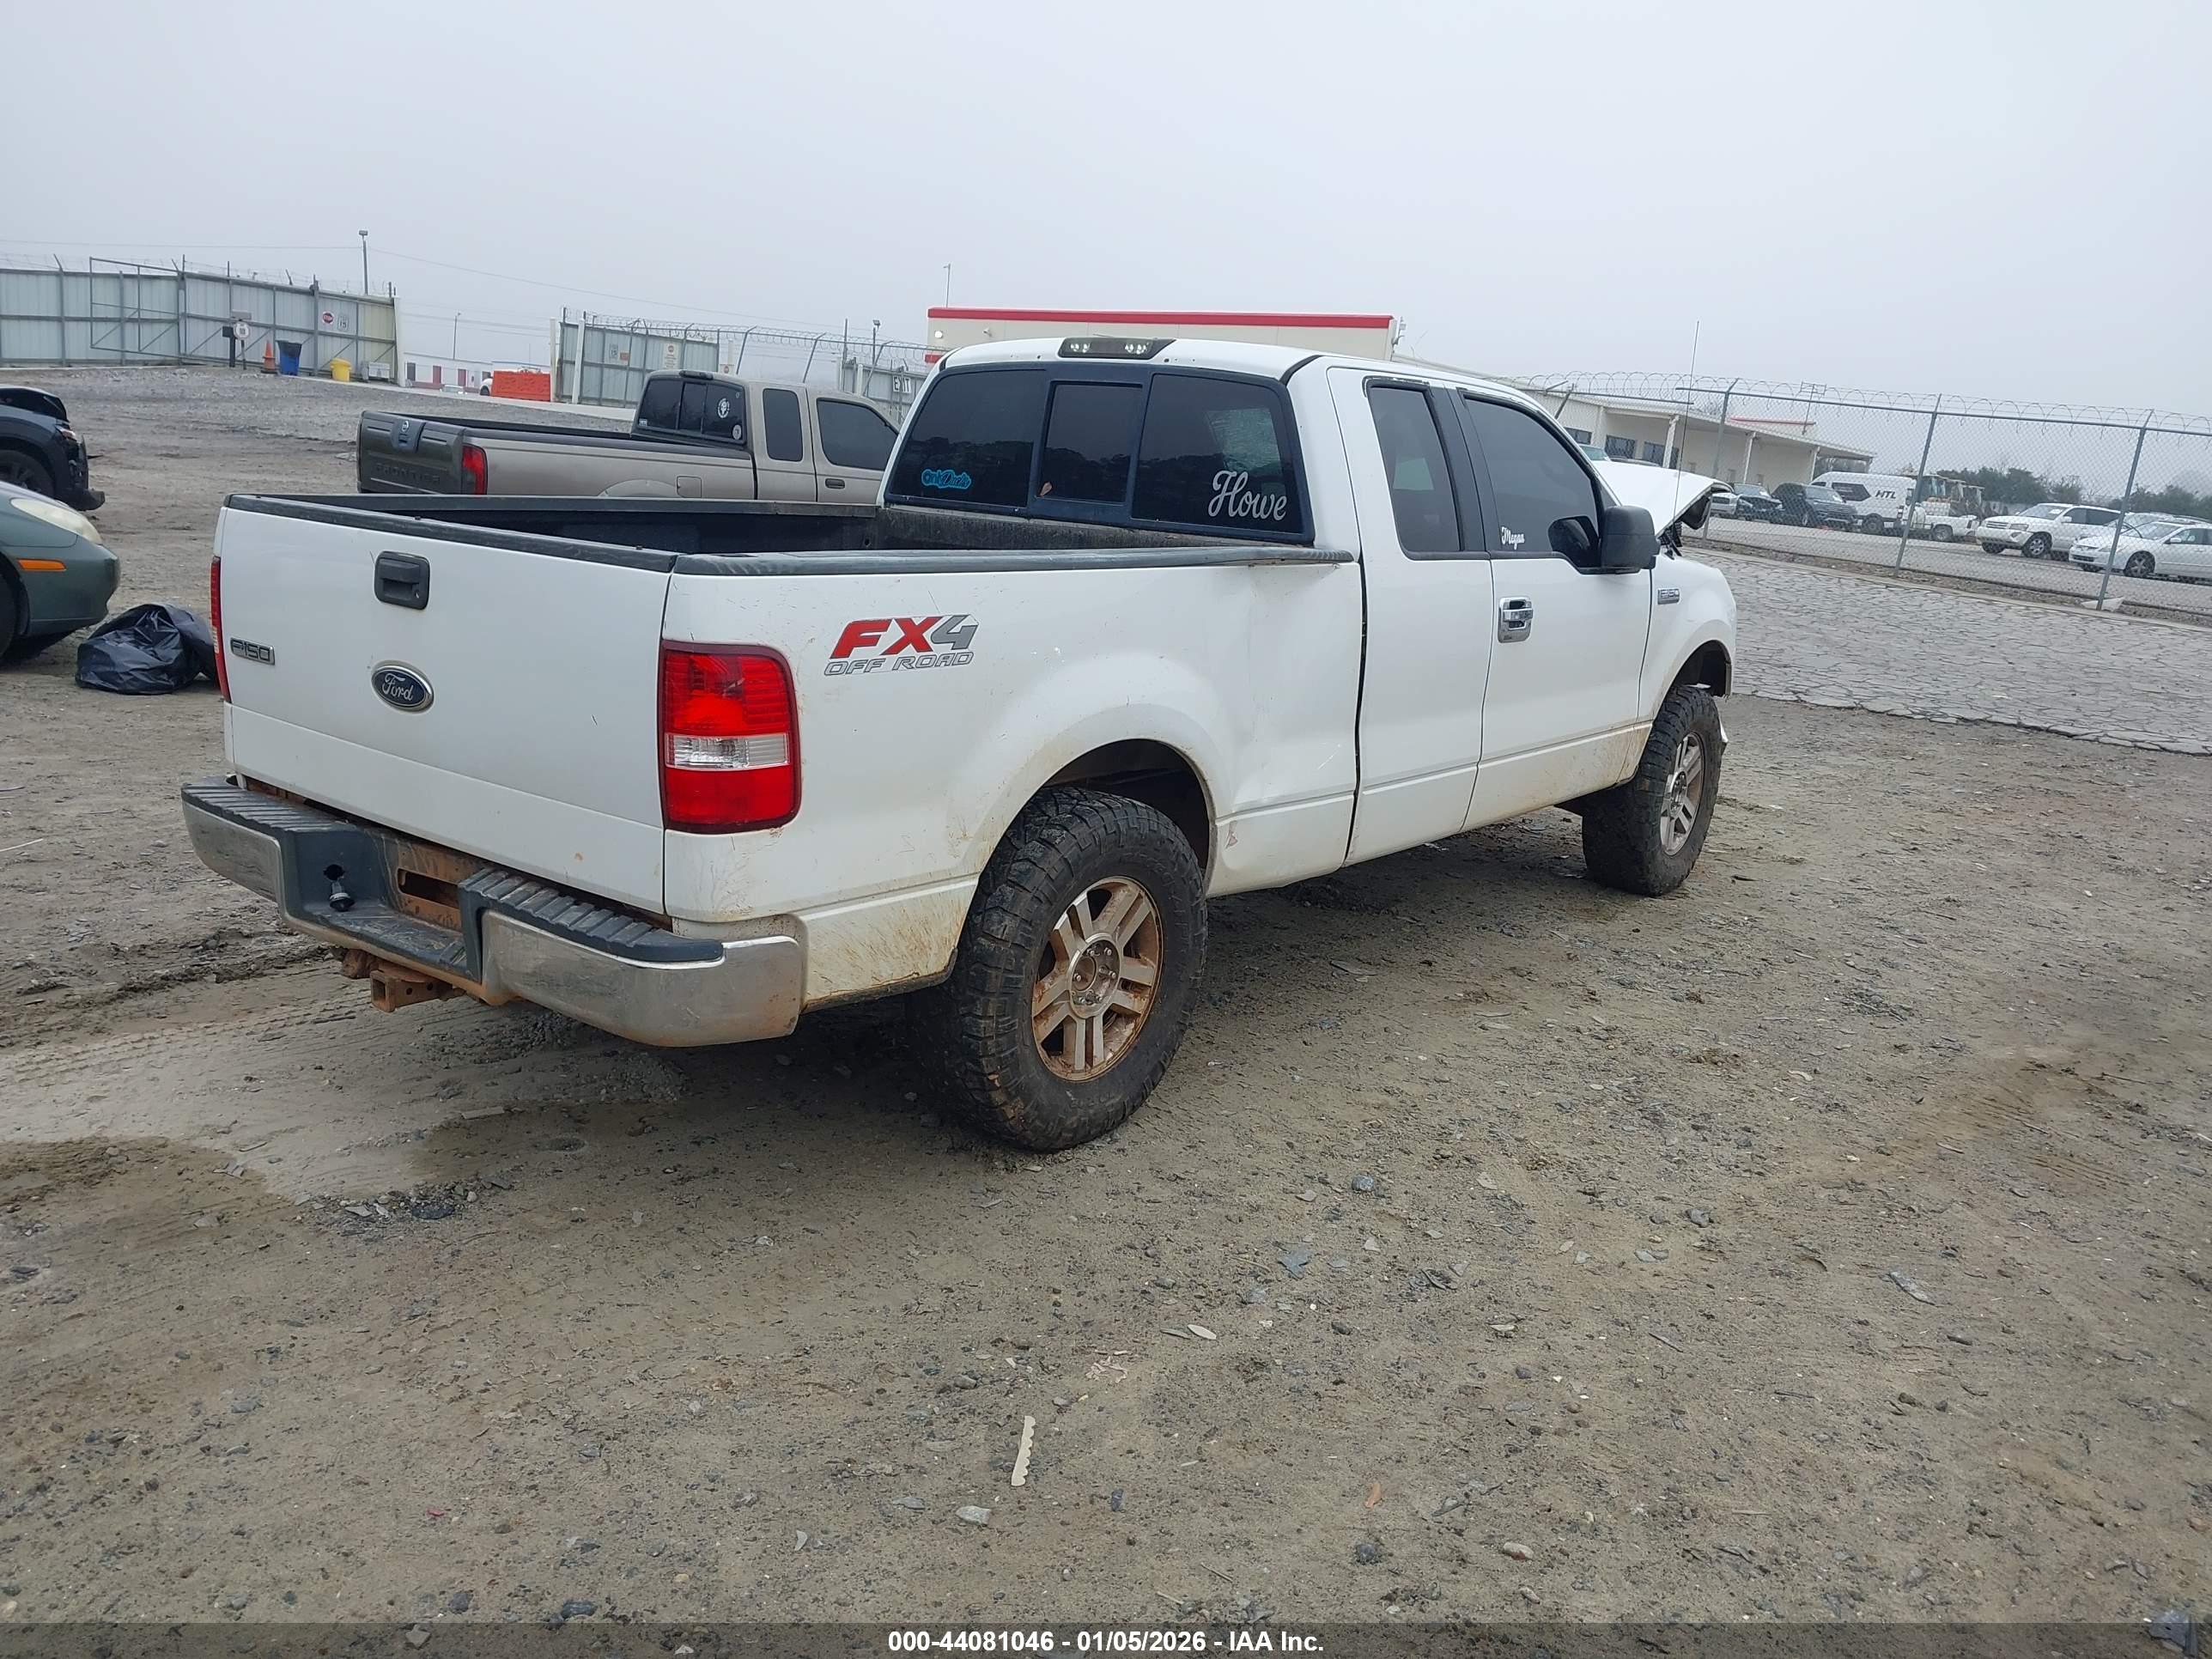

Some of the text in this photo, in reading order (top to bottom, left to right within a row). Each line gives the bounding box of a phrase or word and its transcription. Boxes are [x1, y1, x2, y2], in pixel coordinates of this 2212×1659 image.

[1208, 470, 1287, 520] Howe
[1875, 489, 1897, 500] HTL
[1501, 526, 1525, 550] Megan
[830, 615, 978, 659] FX4
[824, 652, 974, 676] OFF ROAD
[382, 673, 414, 701] Ford
